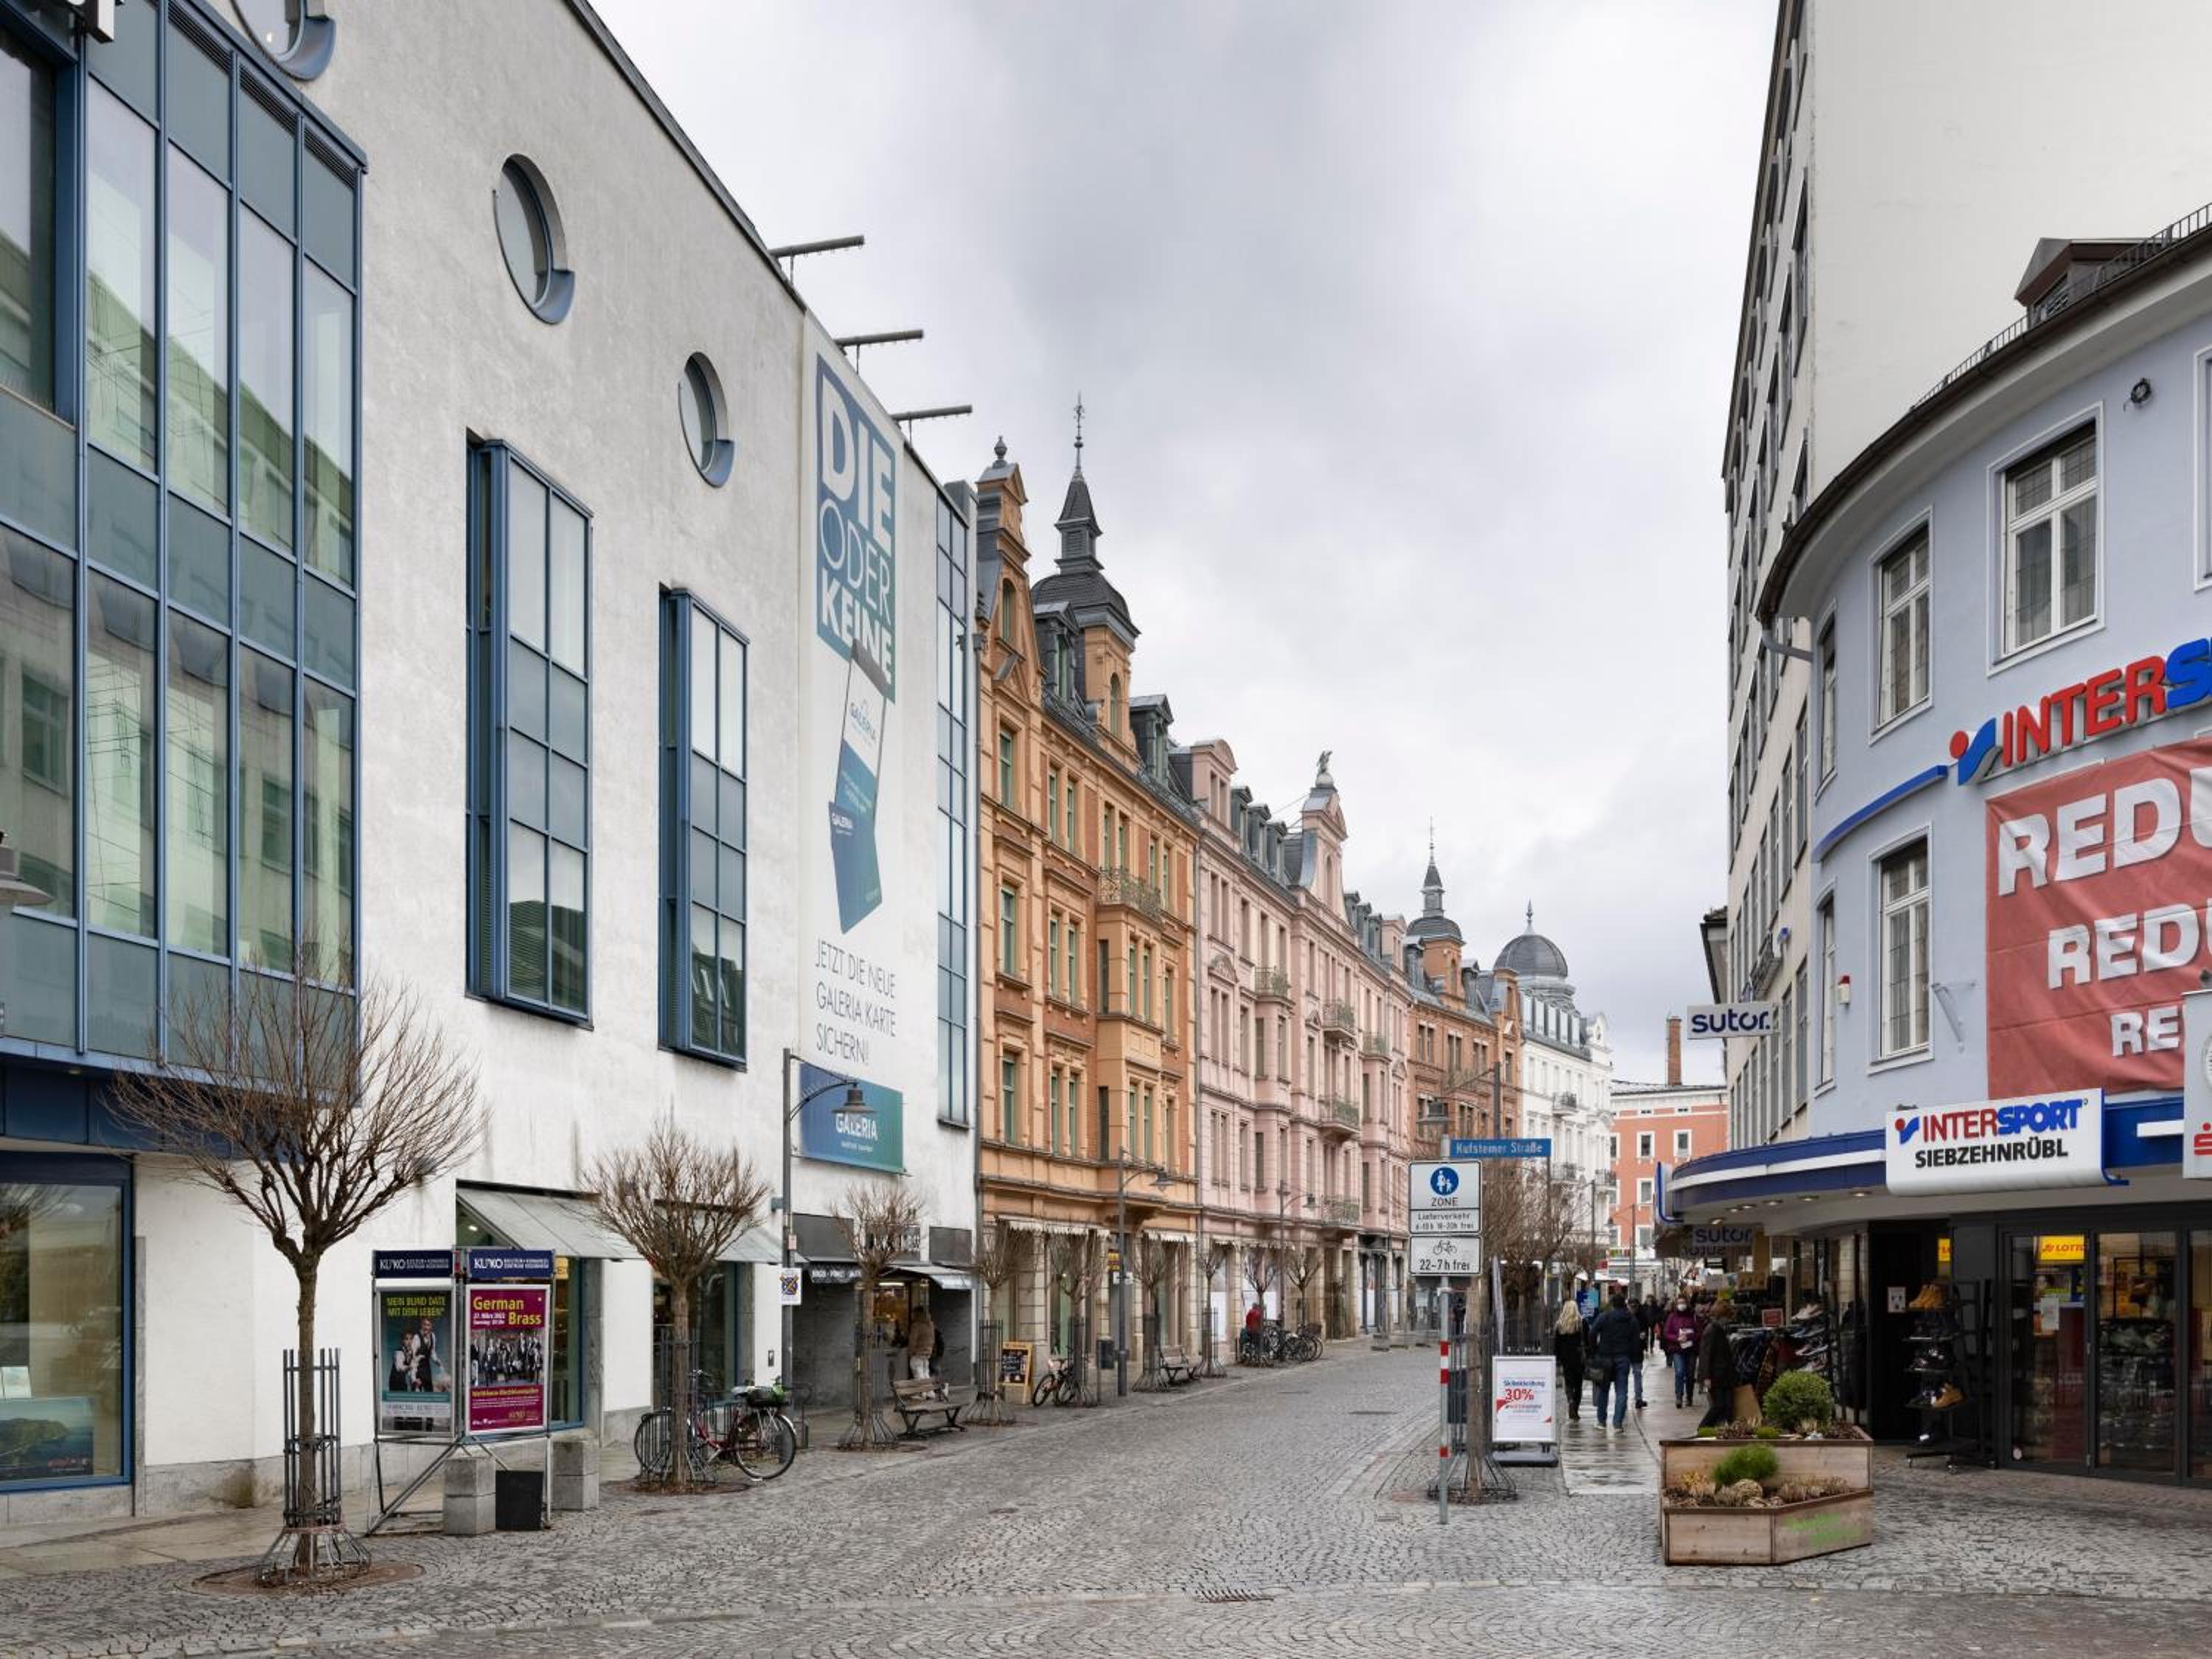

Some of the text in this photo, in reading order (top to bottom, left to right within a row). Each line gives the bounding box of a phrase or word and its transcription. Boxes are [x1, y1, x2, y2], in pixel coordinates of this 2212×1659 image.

[821, 374, 891, 557] DIE
[820, 498, 891, 626] ODER
[821, 566, 892, 684] KEINE
[2003, 637, 2212, 768] INTERS
[2048, 897, 2212, 990] RED
[815, 936, 895, 999] JETZT DIE NEUE
[816, 981, 895, 1037] GALERIA KARTE
[2111, 1004, 2185, 1057] RE
[816, 1023, 869, 1066] SICHERN!
[835, 1113, 878, 1141] GALERIA
[1922, 1099, 2083, 1143] INTERSPORT
[1511, 1141, 1543, 1153] Straße
[1915, 1136, 2068, 1169] SIEBZEHNRÜBL
[1431, 1197, 1458, 1207] ZONE
[1419, 1259, 1443, 1270] 22-7
[1453, 1259, 1470, 1270] frei
[473, 1296, 524, 1310] German
[508, 1312, 542, 1325] Brass
[1505, 1388, 1534, 1400] 30%
